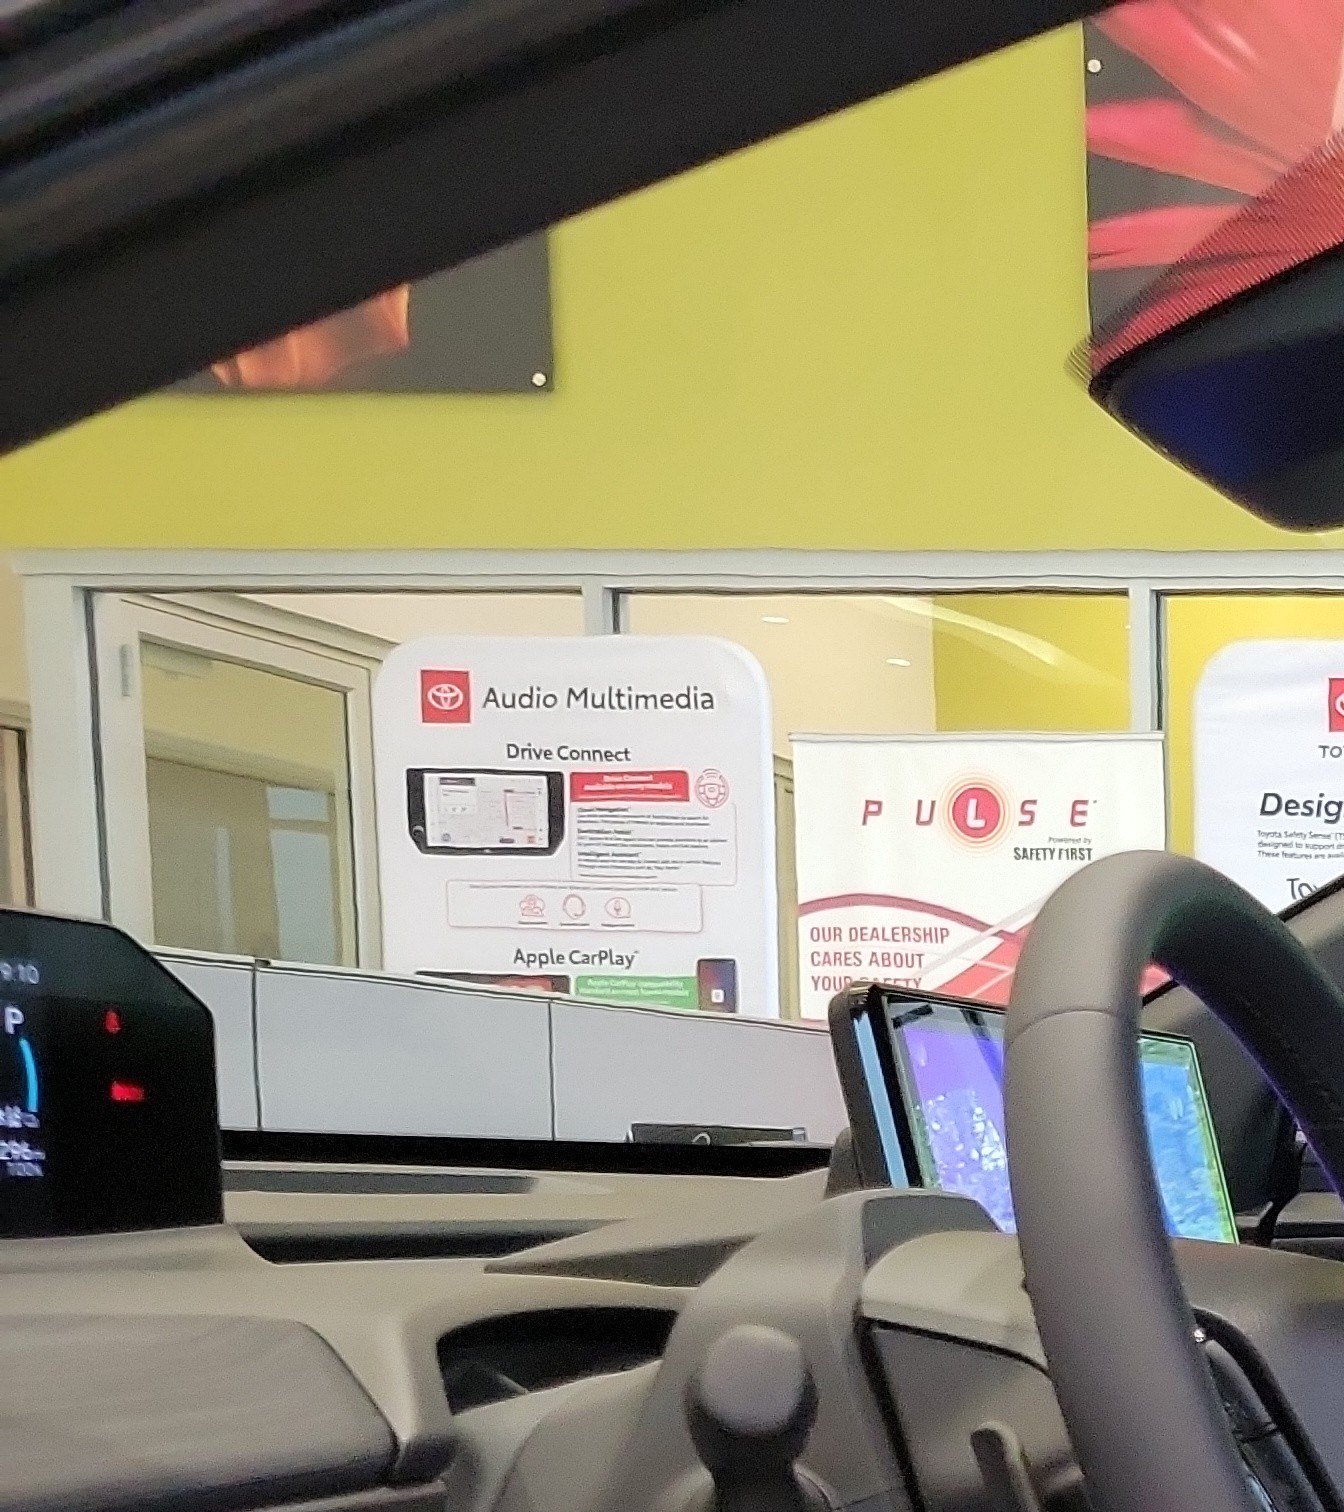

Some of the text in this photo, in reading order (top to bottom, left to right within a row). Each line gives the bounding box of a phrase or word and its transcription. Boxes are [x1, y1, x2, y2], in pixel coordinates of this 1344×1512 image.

[483, 686, 715, 711] Audio Multimedia
[506, 743, 632, 763] Drive Connect
[861, 798, 1090, 828] PULSE
[1284, 831, 1307, 840] Safety
[1013, 846, 1056, 861] SAFETY
[810, 926, 950, 944] OUR DEALERSHIP
[513, 948, 565, 967] Apple
[810, 951, 925, 968] CARES ABOUT
[5, 1006, 25, 1035] P
